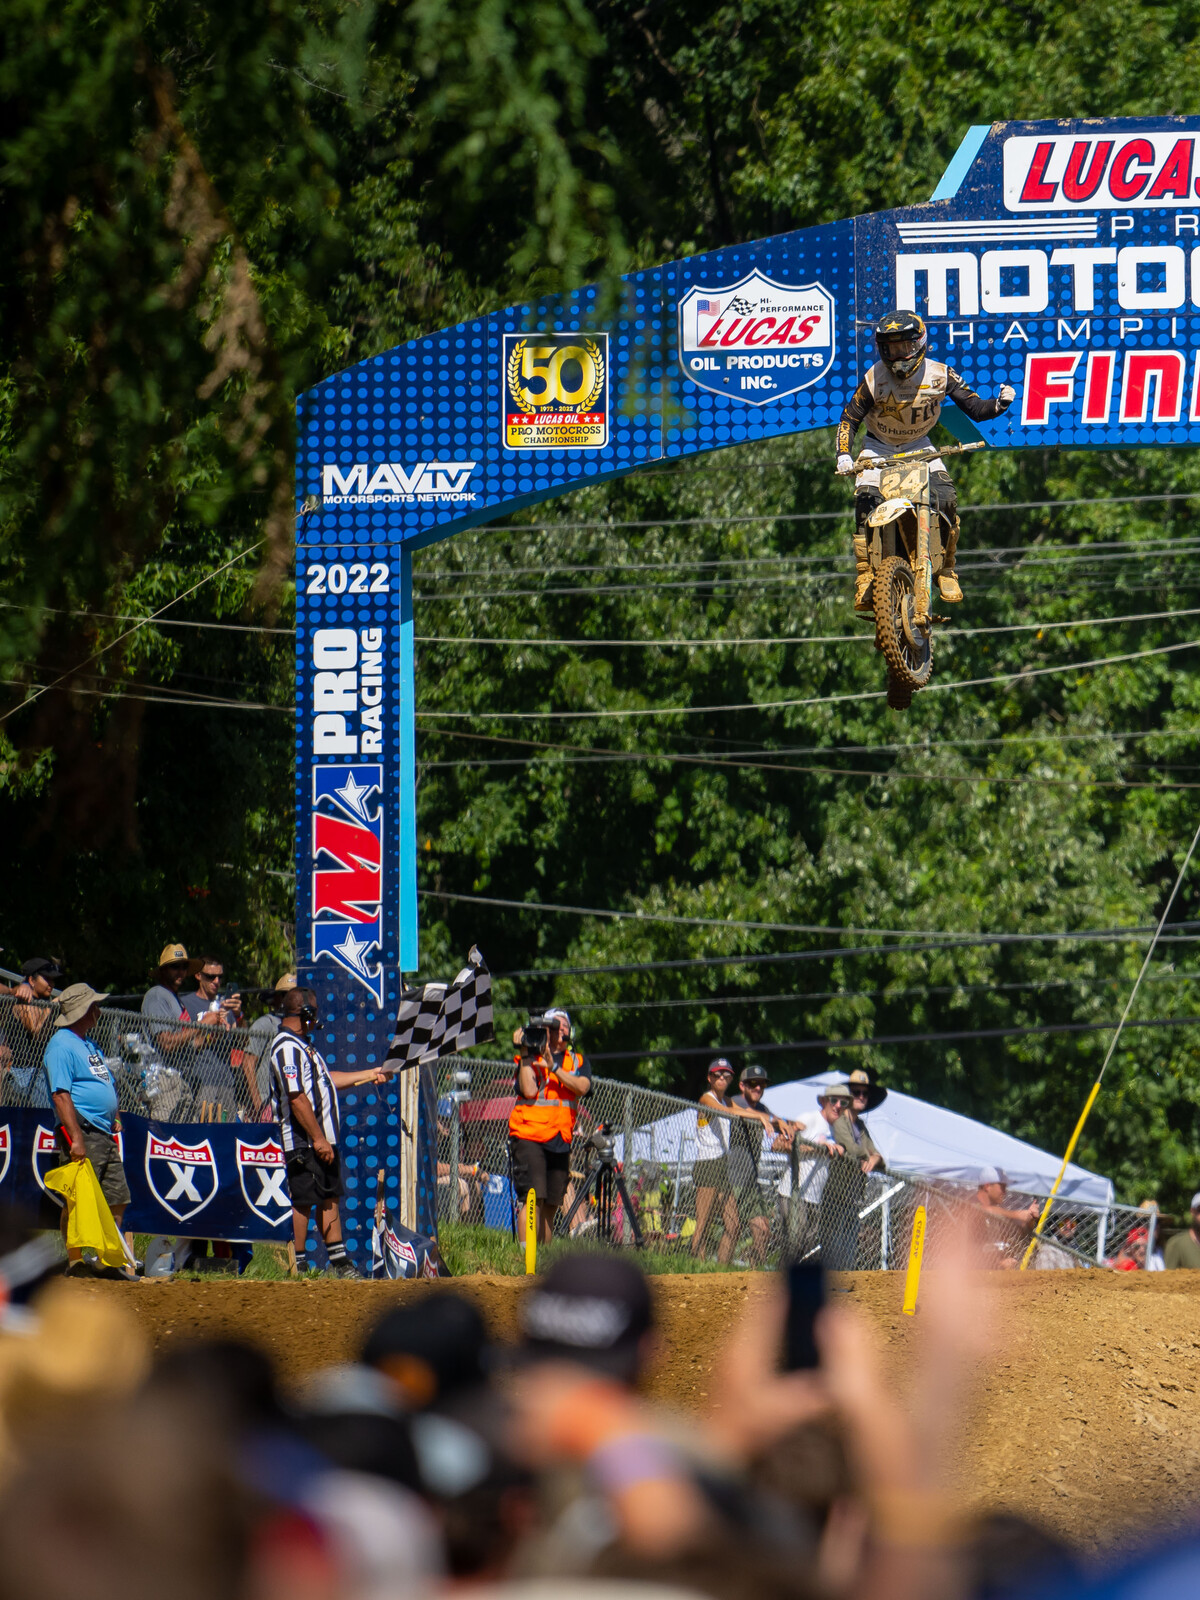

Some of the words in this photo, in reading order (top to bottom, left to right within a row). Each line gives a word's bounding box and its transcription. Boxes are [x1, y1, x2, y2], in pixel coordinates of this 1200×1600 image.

[760, 304, 824, 313] PERFORMANCE
[697, 315, 822, 348] LUCAS
[519, 345, 596, 406] 50
[690, 357, 721, 371] OIL
[726, 353, 824, 370] PRODUCTS
[510, 426, 533, 436] PRO
[536, 425, 601, 435] MOTOCROSS
[533, 414, 564, 425] LUCAS
[564, 414, 579, 424] OIL
[523, 436, 589, 444] CHAMPIONSHIP
[323, 462, 477, 496] MAVTV
[882, 470, 921, 498] 24
[323, 494, 415, 505] MOTORSPORTS
[417, 492, 477, 502] NETWORK
[306, 563, 390, 595] 2022
[313, 628, 358, 755] PRO
[360, 627, 383, 754] RACING
[153, 1144, 207, 1161] RACER
[164, 1161, 203, 1202] X
[254, 1168, 292, 1207] X
